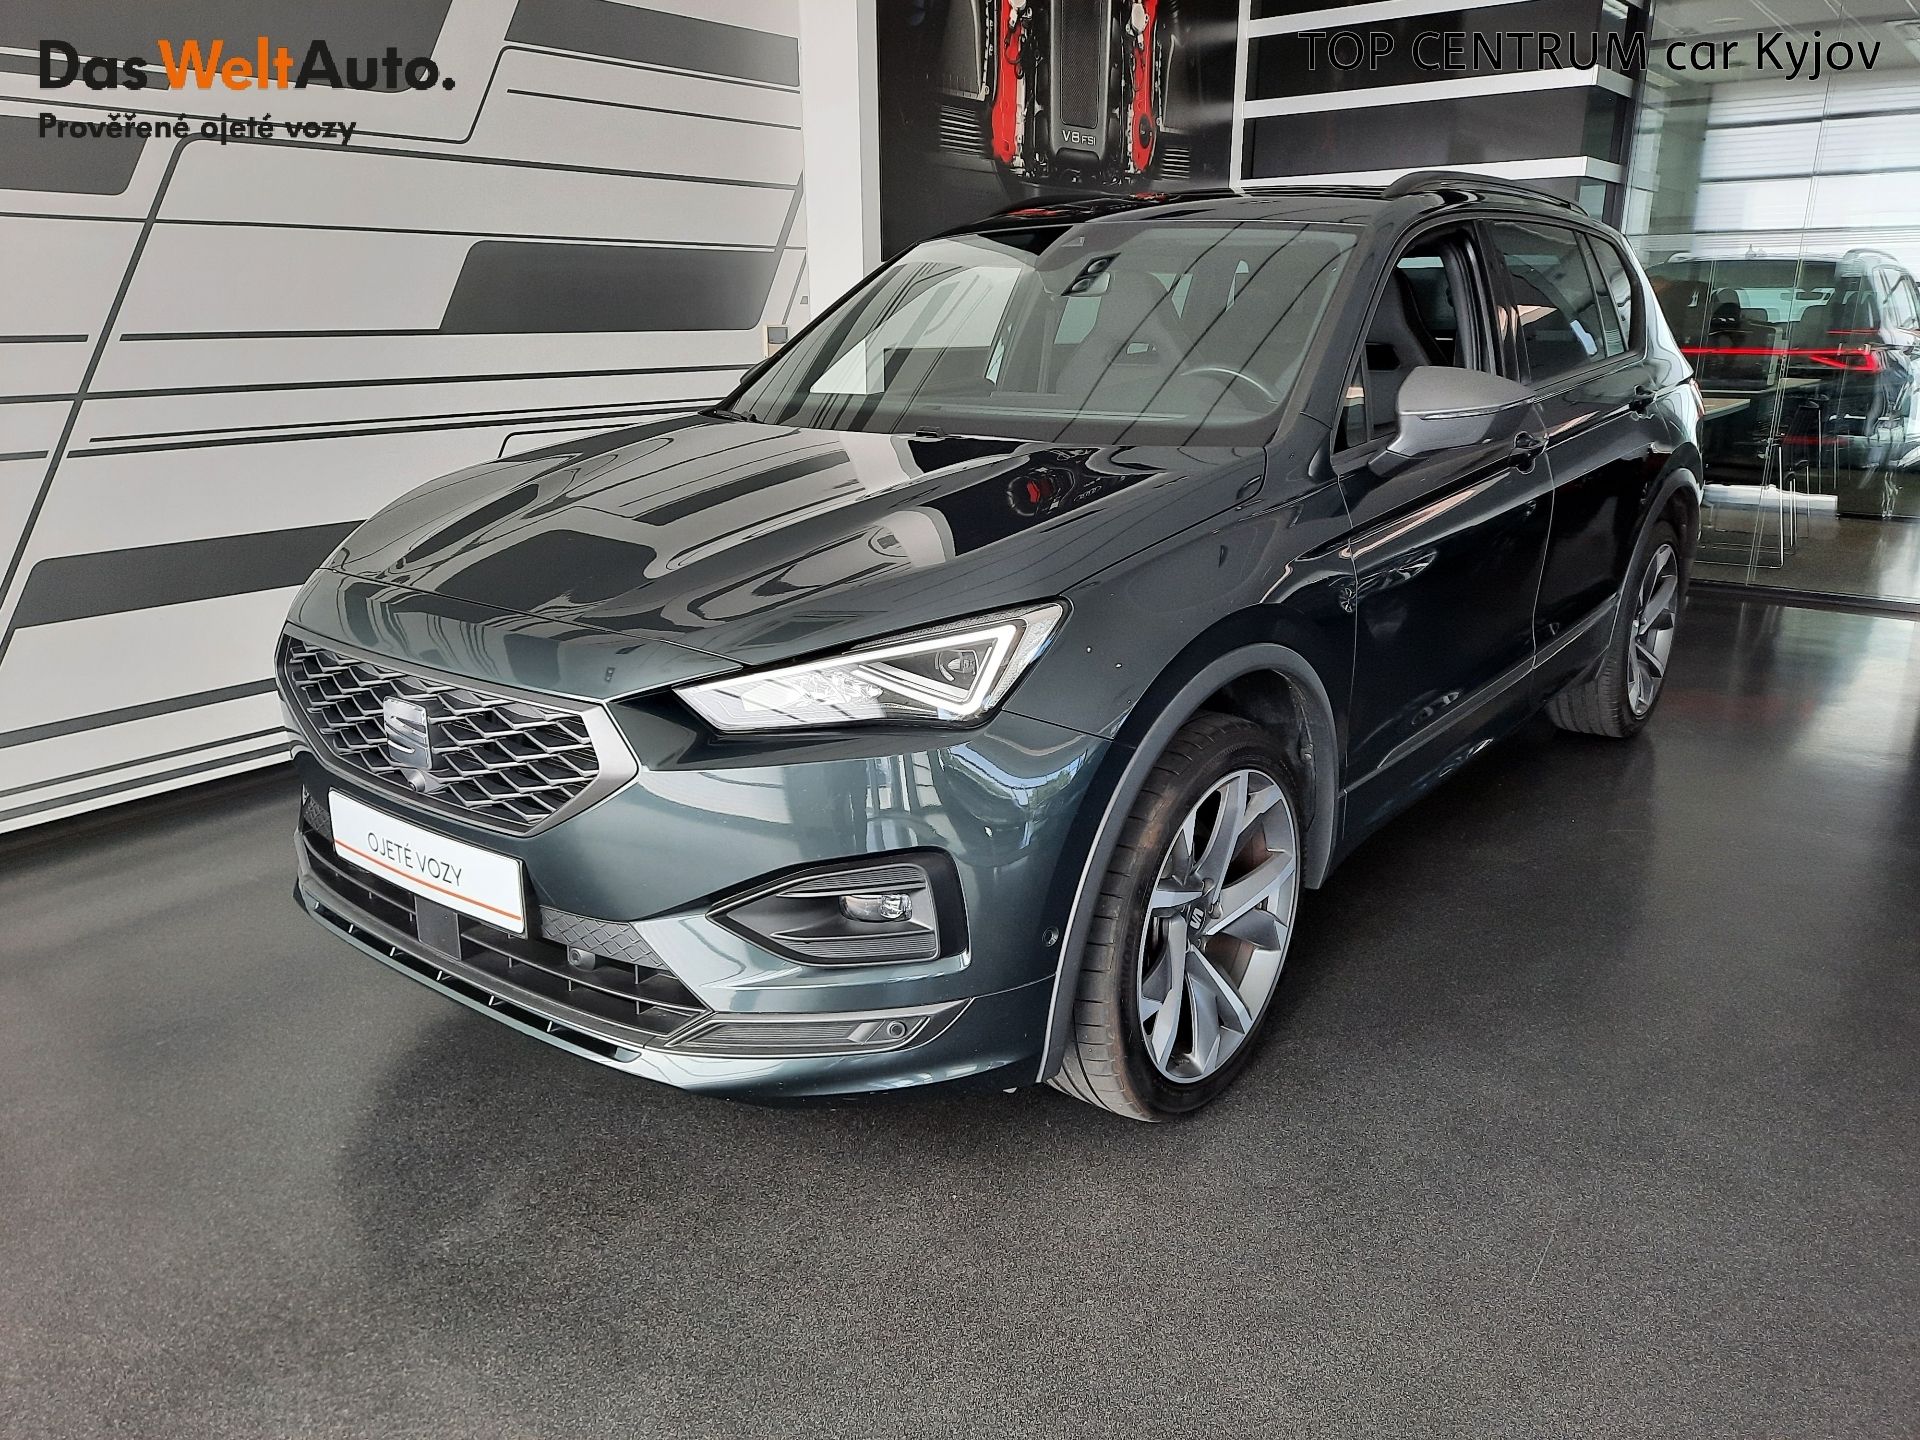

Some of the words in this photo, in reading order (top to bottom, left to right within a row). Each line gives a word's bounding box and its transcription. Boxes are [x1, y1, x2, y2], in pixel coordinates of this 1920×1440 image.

[1062, 130, 1080, 143] V8
[1081, 135, 1096, 146] FSI
[367, 832, 413, 868] OJETÉ
[415, 851, 462, 886] VOZY
